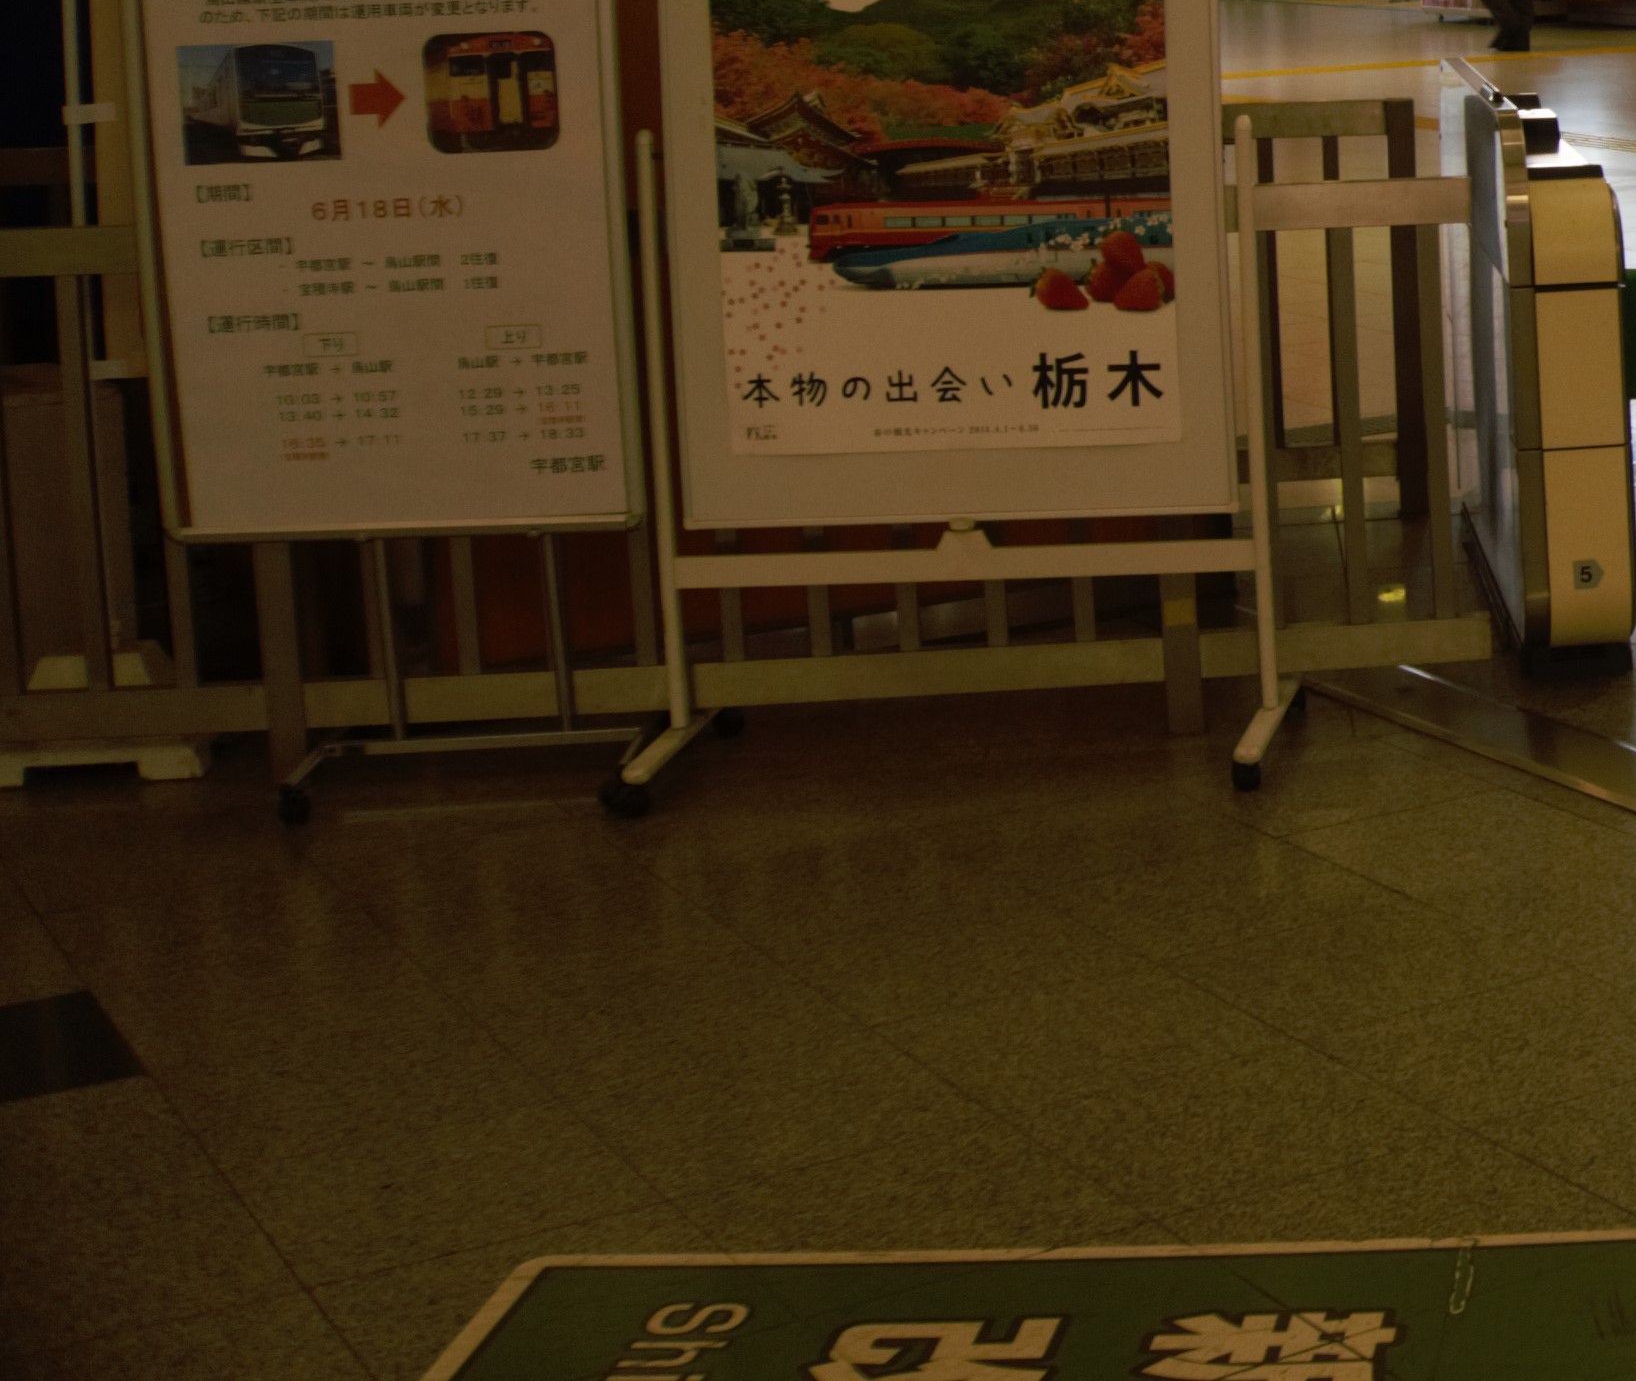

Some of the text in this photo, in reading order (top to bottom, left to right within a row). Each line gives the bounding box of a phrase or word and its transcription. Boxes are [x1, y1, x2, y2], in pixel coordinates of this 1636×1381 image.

[311, 194, 466, 222] 6月18日(水)
[501, 330, 528, 345] 上り
[744, 350, 1164, 409] 本物の出会い 栃木
[1580, 565, 1592, 583] 5
